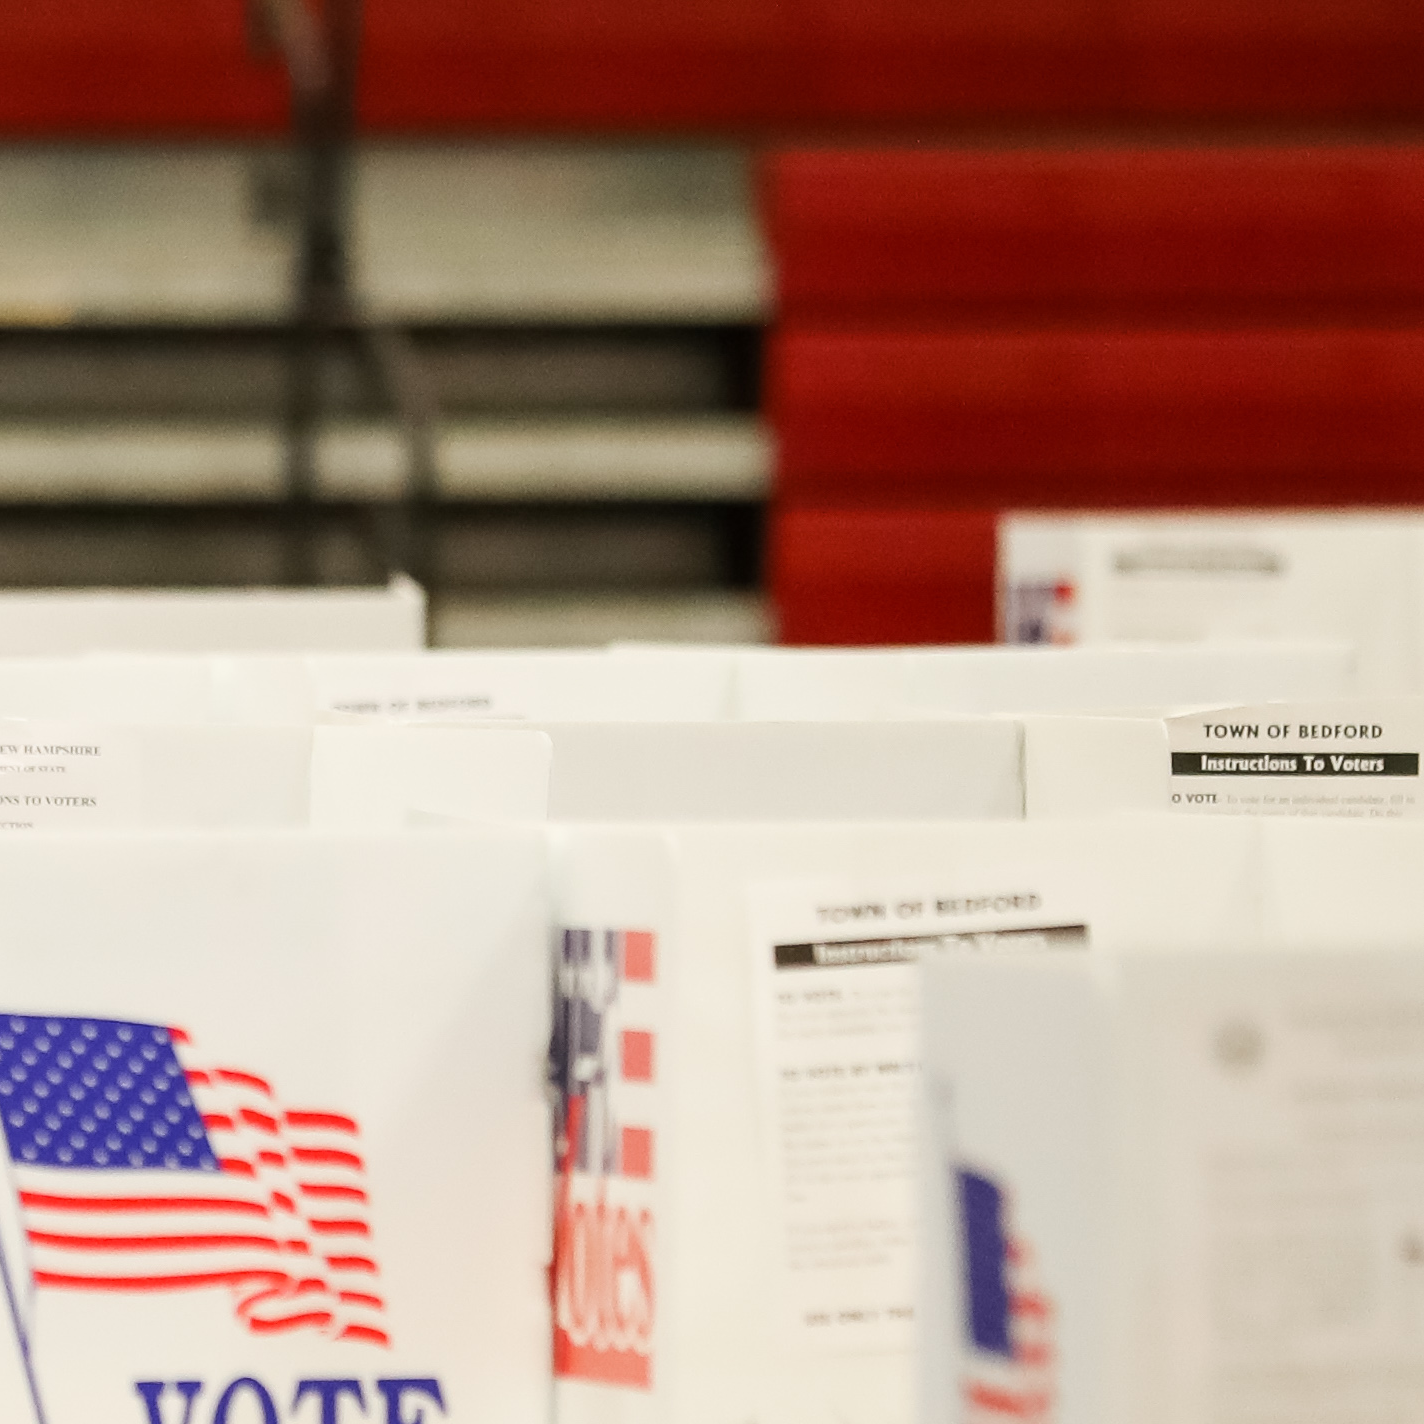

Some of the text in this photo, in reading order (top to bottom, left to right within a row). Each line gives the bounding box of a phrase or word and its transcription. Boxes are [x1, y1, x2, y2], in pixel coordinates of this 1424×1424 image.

[1203, 724, 1384, 739] TOWN OF BEDFORD
[23, 744, 102, 757] HAMPSHIRE
[1200, 754, 1386, 772] Instructions To Voters
[25, 795, 42, 807] TO
[45, 795, 98, 808] VOTERS
